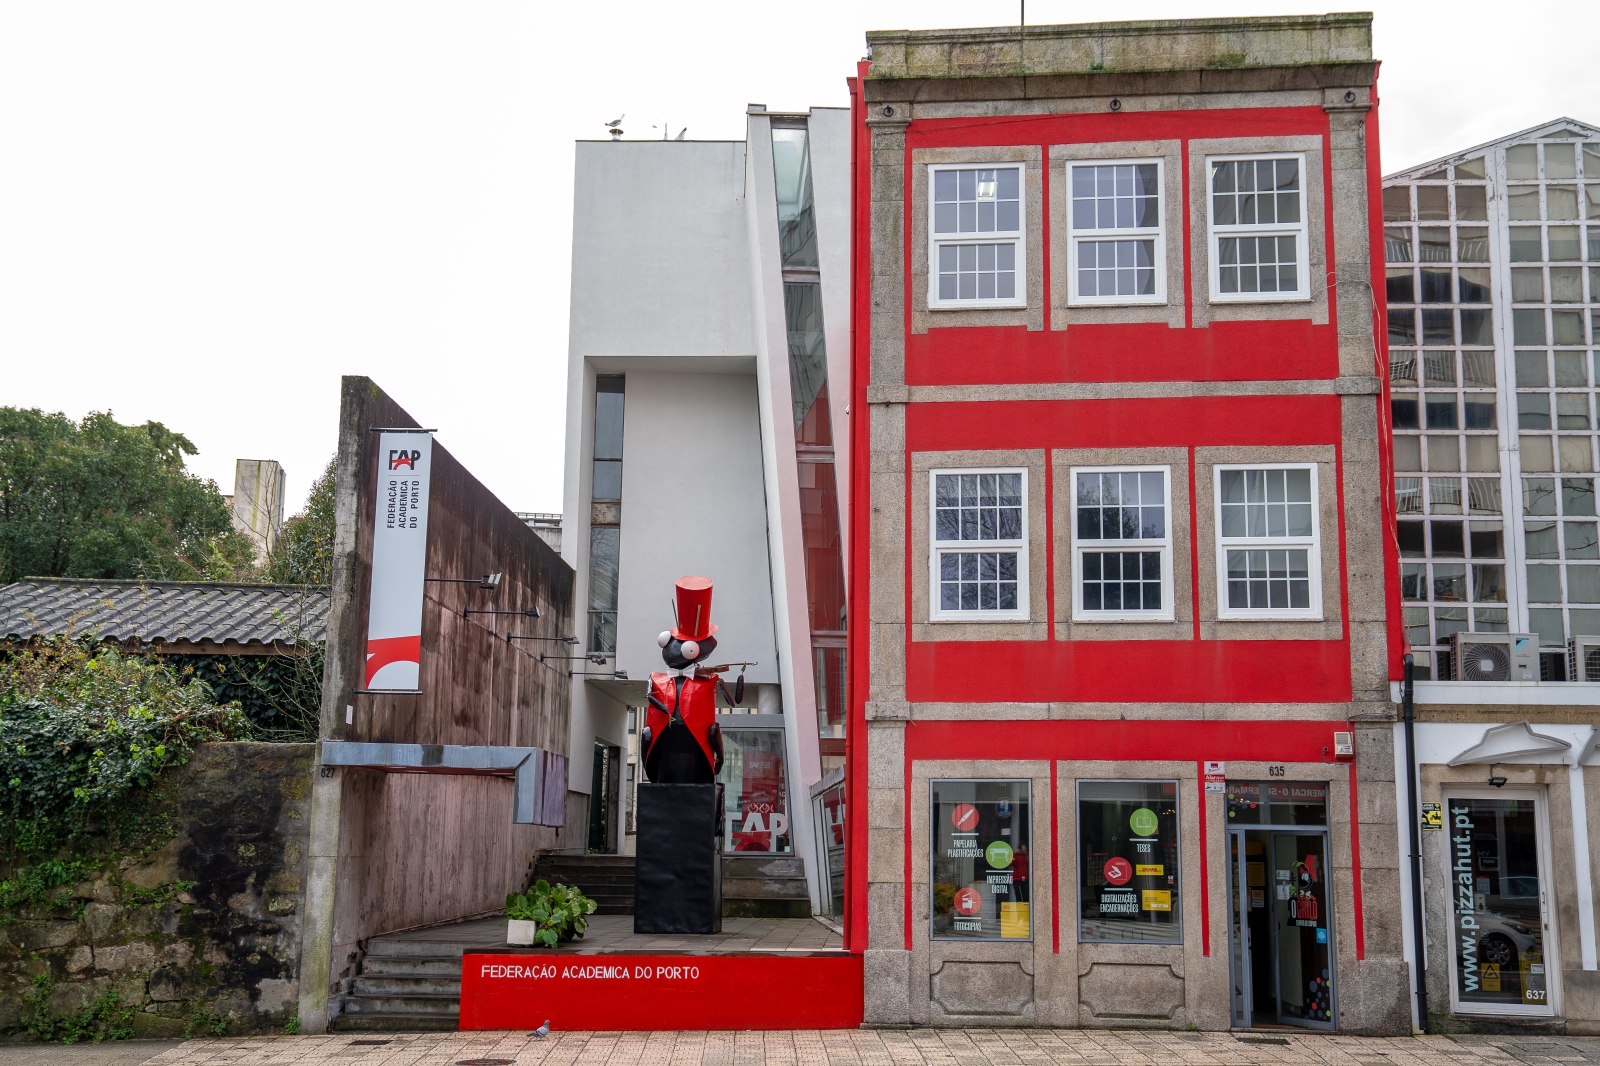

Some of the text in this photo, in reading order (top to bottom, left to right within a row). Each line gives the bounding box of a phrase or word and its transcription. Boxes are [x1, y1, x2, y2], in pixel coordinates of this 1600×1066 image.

[388, 450, 421, 470] FAP
[387, 480, 397, 529] FEDERAÇÃO
[410, 480, 420, 529] DO PORTO
[320, 767, 335, 778] 627
[1269, 766, 1285, 776] 635
[724, 811, 789, 852] FAP
[953, 839, 978, 848] PAPELARIA
[1136, 843, 1151, 853] TESES
[947, 847, 984, 859] PLASTIFICAÇÕES
[986, 873, 1014, 884] IMPRESSÃO
[991, 884, 1009, 894] DIGITAL
[1101, 892, 1137, 904] DIGITALIZAÇÕES
[1451, 806, 1480, 992] www.pizzahut.pt
[1100, 903, 1139, 914] ENCADERNAÇÕES
[1291, 899, 1319, 920] O GRILO
[481, 963, 700, 980] FEDERAÇÃO ACADEMICA DO PORTO
[1525, 990, 1545, 1000] 637
